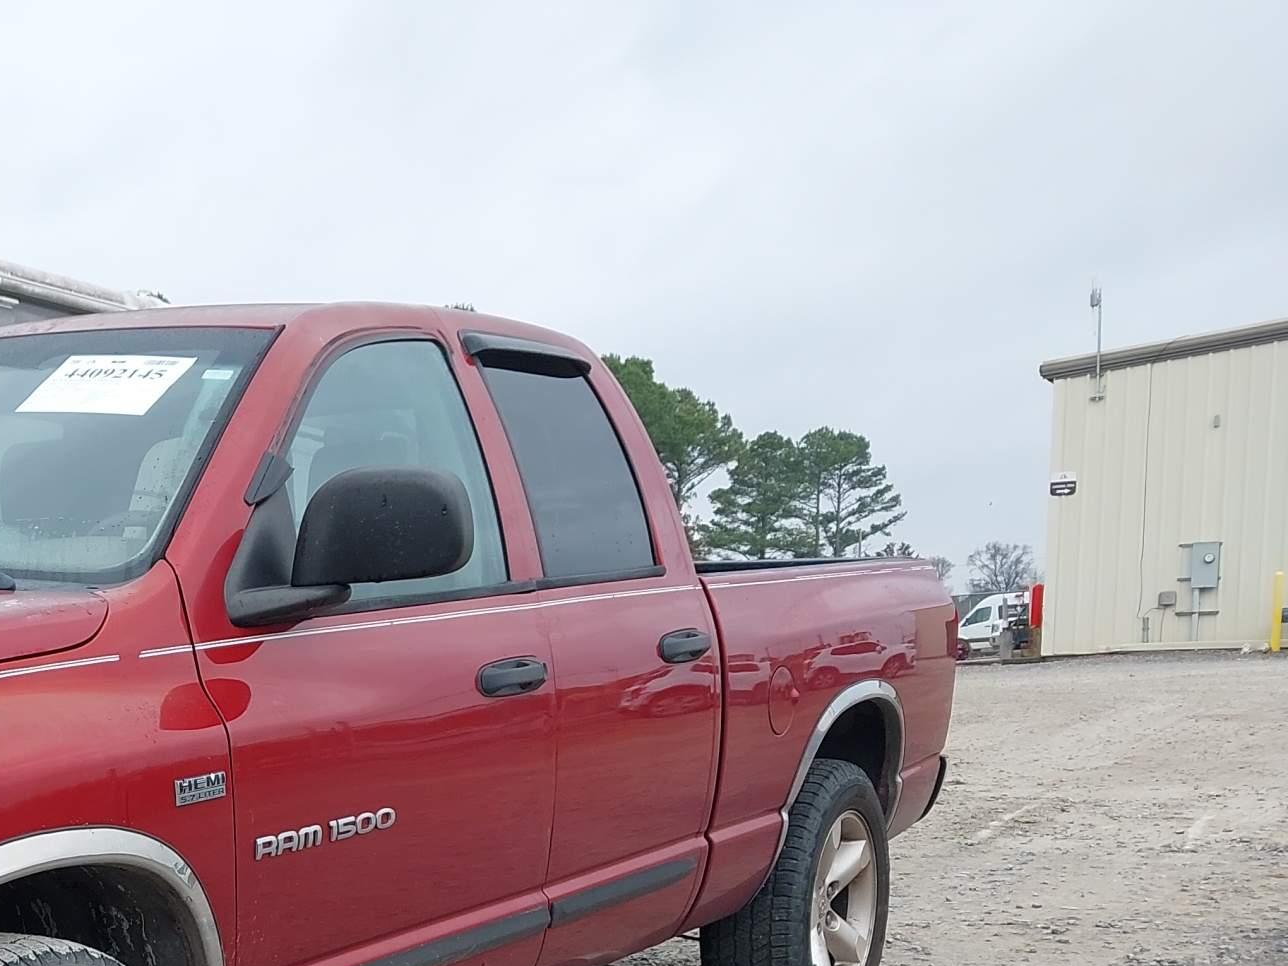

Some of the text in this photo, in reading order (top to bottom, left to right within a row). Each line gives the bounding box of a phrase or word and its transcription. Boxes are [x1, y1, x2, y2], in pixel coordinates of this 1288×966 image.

[64, 368, 168, 380] 44092145
[178, 772, 225, 795] HEMI
[179, 787, 225, 804] 5.7 LITER
[255, 807, 397, 861] RAM 1500
